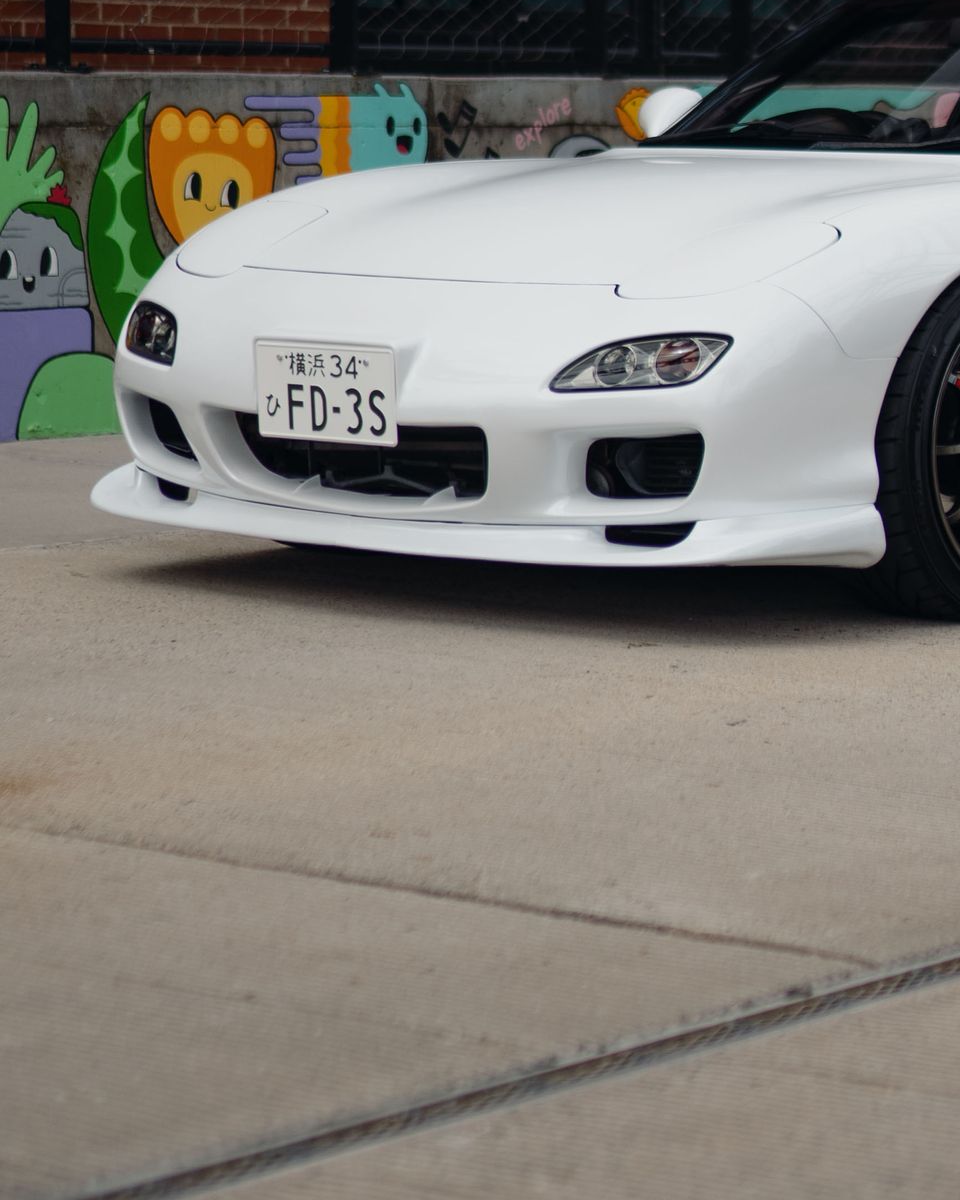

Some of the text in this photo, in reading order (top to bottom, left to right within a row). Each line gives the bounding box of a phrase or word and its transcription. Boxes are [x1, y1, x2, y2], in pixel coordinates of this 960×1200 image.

[515, 97, 572, 150] explore
[289, 352, 358, 379] 横浜 34
[265, 383, 387, 436] ひ FD-3S
